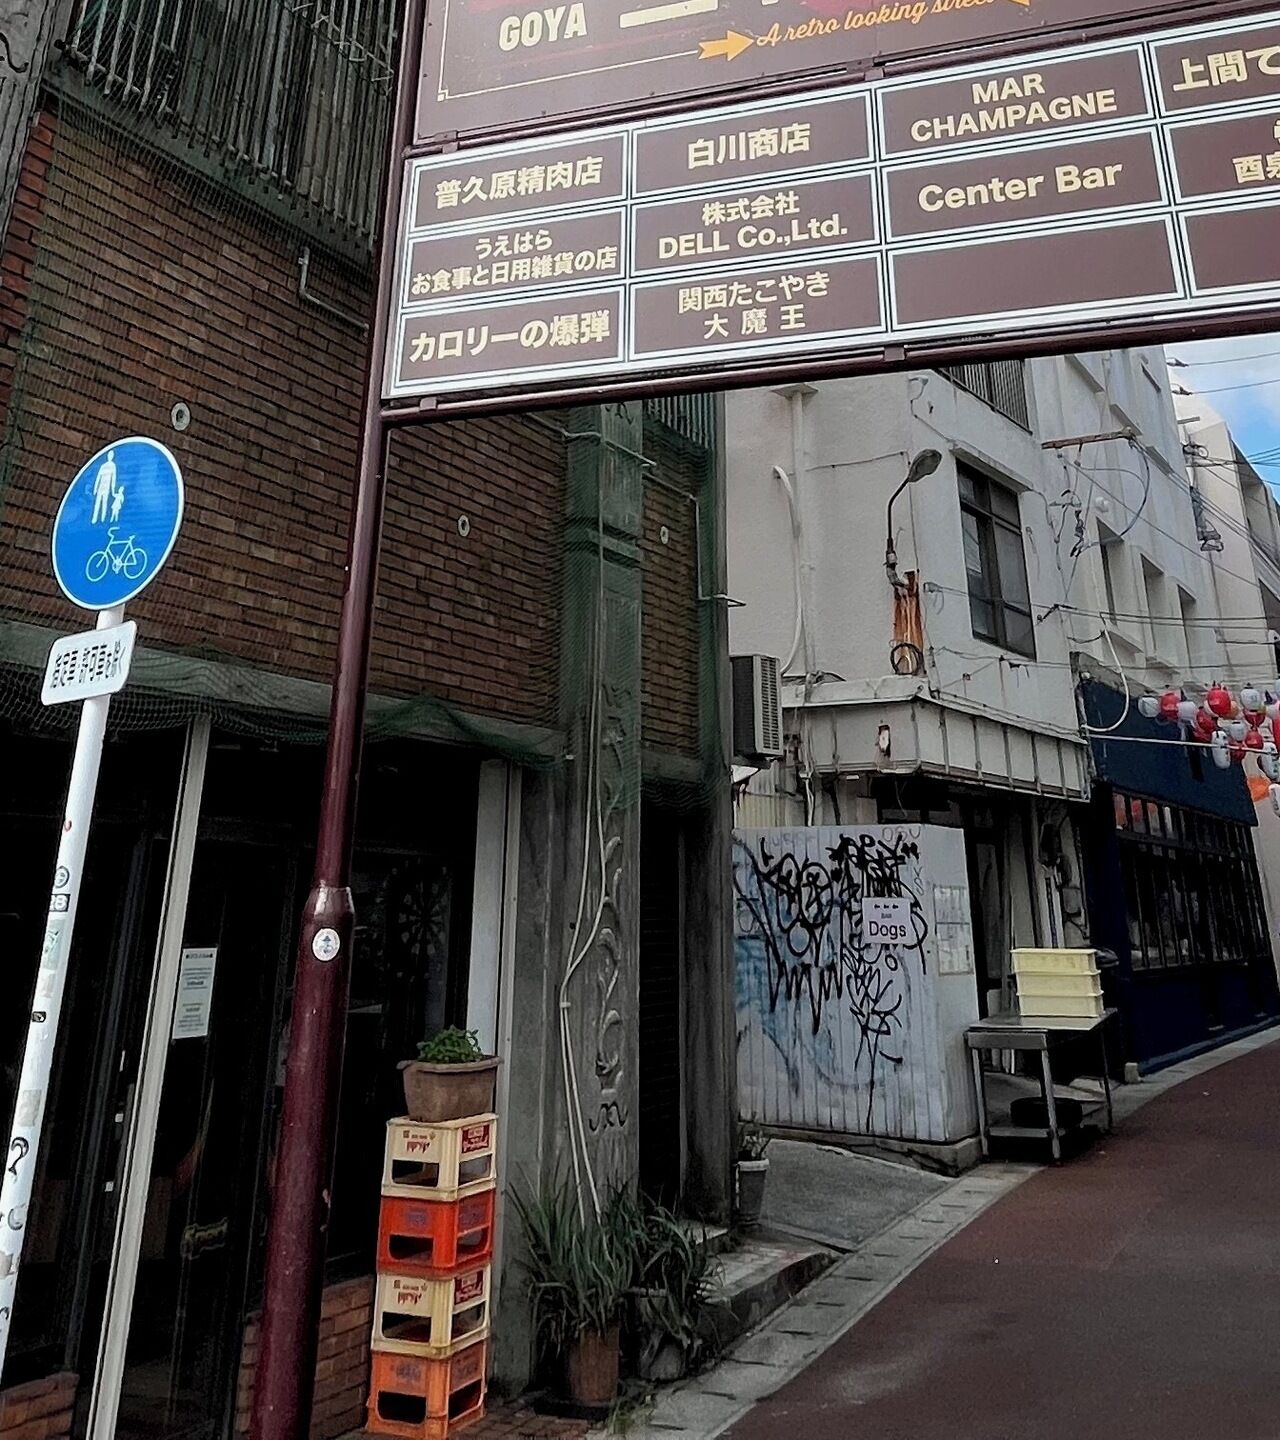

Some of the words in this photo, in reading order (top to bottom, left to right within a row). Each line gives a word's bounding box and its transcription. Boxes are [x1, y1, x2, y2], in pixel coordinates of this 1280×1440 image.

[498, 1, 588, 52] GOYA
[756, 19, 783, 48] A
[782, 14, 841, 42] retro
[971, 73, 1045, 105] MAR
[911, 89, 1118, 142] CHAMPAGNE
[687, 122, 811, 170] 白川商店
[435, 156, 603, 209] 普久原精肉店
[918, 174, 1043, 212] Center
[1055, 161, 1123, 194] Bar
[702, 190, 800, 226] 株式会社
[474, 229, 553, 260] うえはら
[658, 230, 729, 260] DELL
[737, 213, 849, 250] Co.,Ltd.
[411, 246, 618, 296] お食事と日用雑貨の店
[678, 272, 830, 314] 関西たこやき
[409, 310, 611, 363] カロリーの爆弾
[869, 921, 907, 940] Dogs
